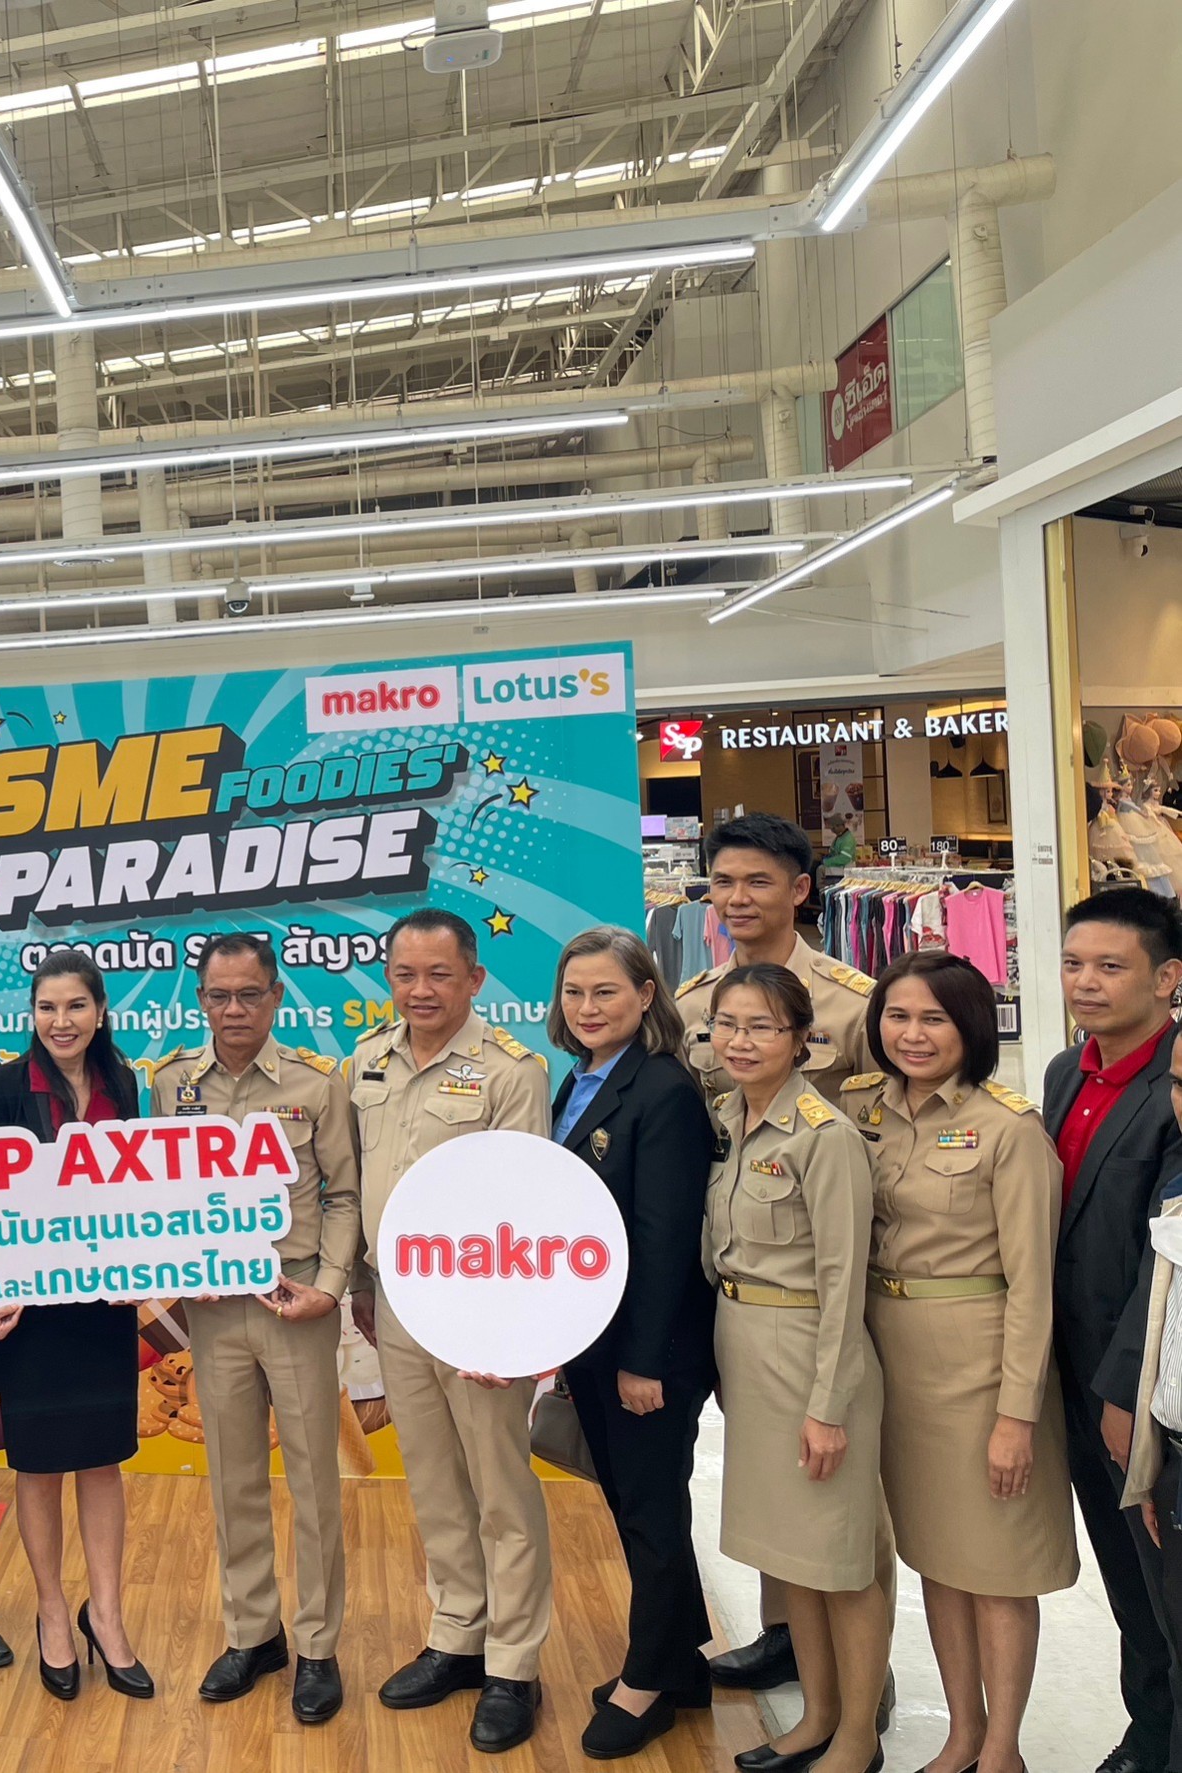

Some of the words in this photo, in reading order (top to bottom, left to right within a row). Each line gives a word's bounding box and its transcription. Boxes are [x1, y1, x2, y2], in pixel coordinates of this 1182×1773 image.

[321, 681, 441, 716] makro
[473, 668, 611, 705] Lotus's
[721, 719, 884, 749] RESTAURANT
[893, 718, 913, 739] &
[214, 743, 460, 813] FOODIES'
[880, 839, 898, 852] 80
[931, 840, 950, 852] 180
[342, 999, 397, 1027] SM
[56, 1122, 292, 1187] AXTRA
[395, 1221, 611, 1281] makro
